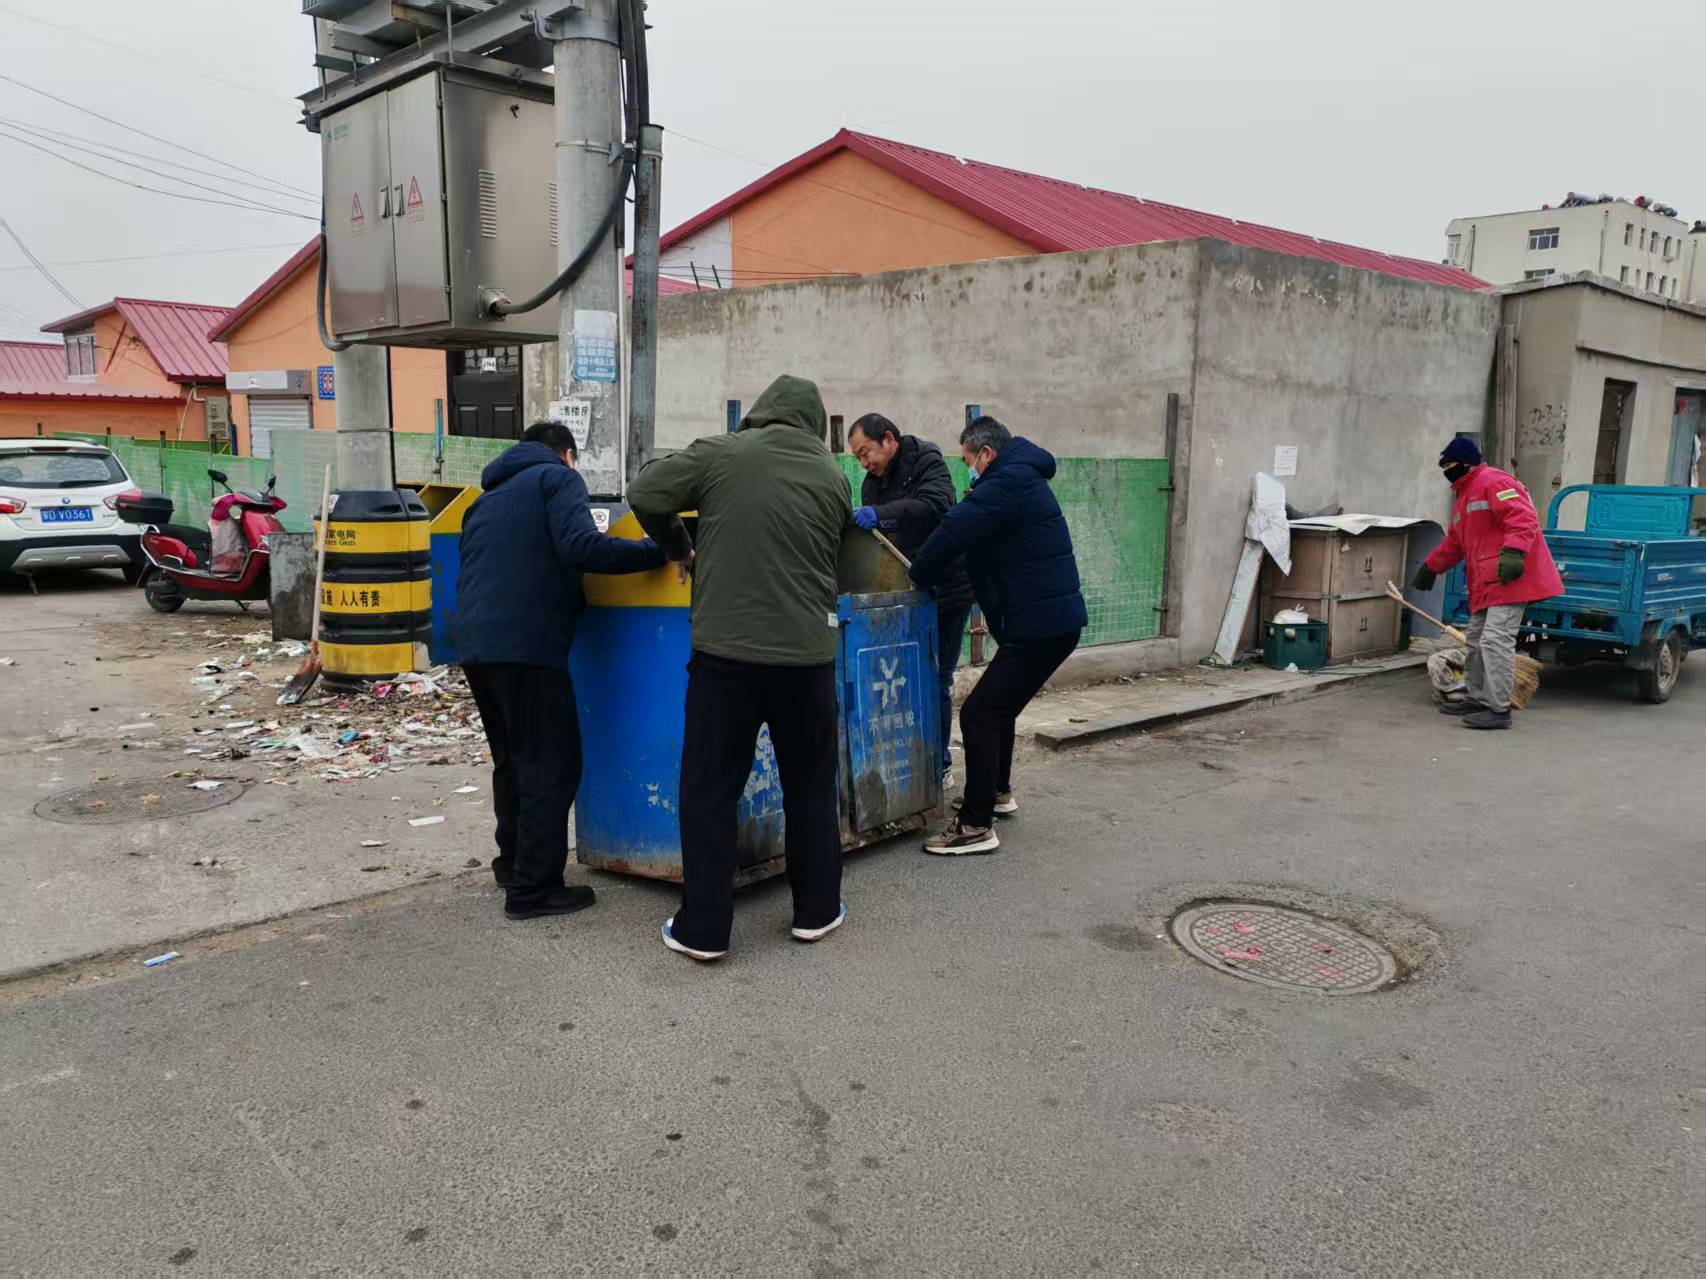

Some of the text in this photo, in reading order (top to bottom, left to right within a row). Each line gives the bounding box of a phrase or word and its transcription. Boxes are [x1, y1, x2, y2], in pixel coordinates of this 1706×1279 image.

[326, 529, 356, 540] 家电网
[340, 590, 381, 607] 人人有责
